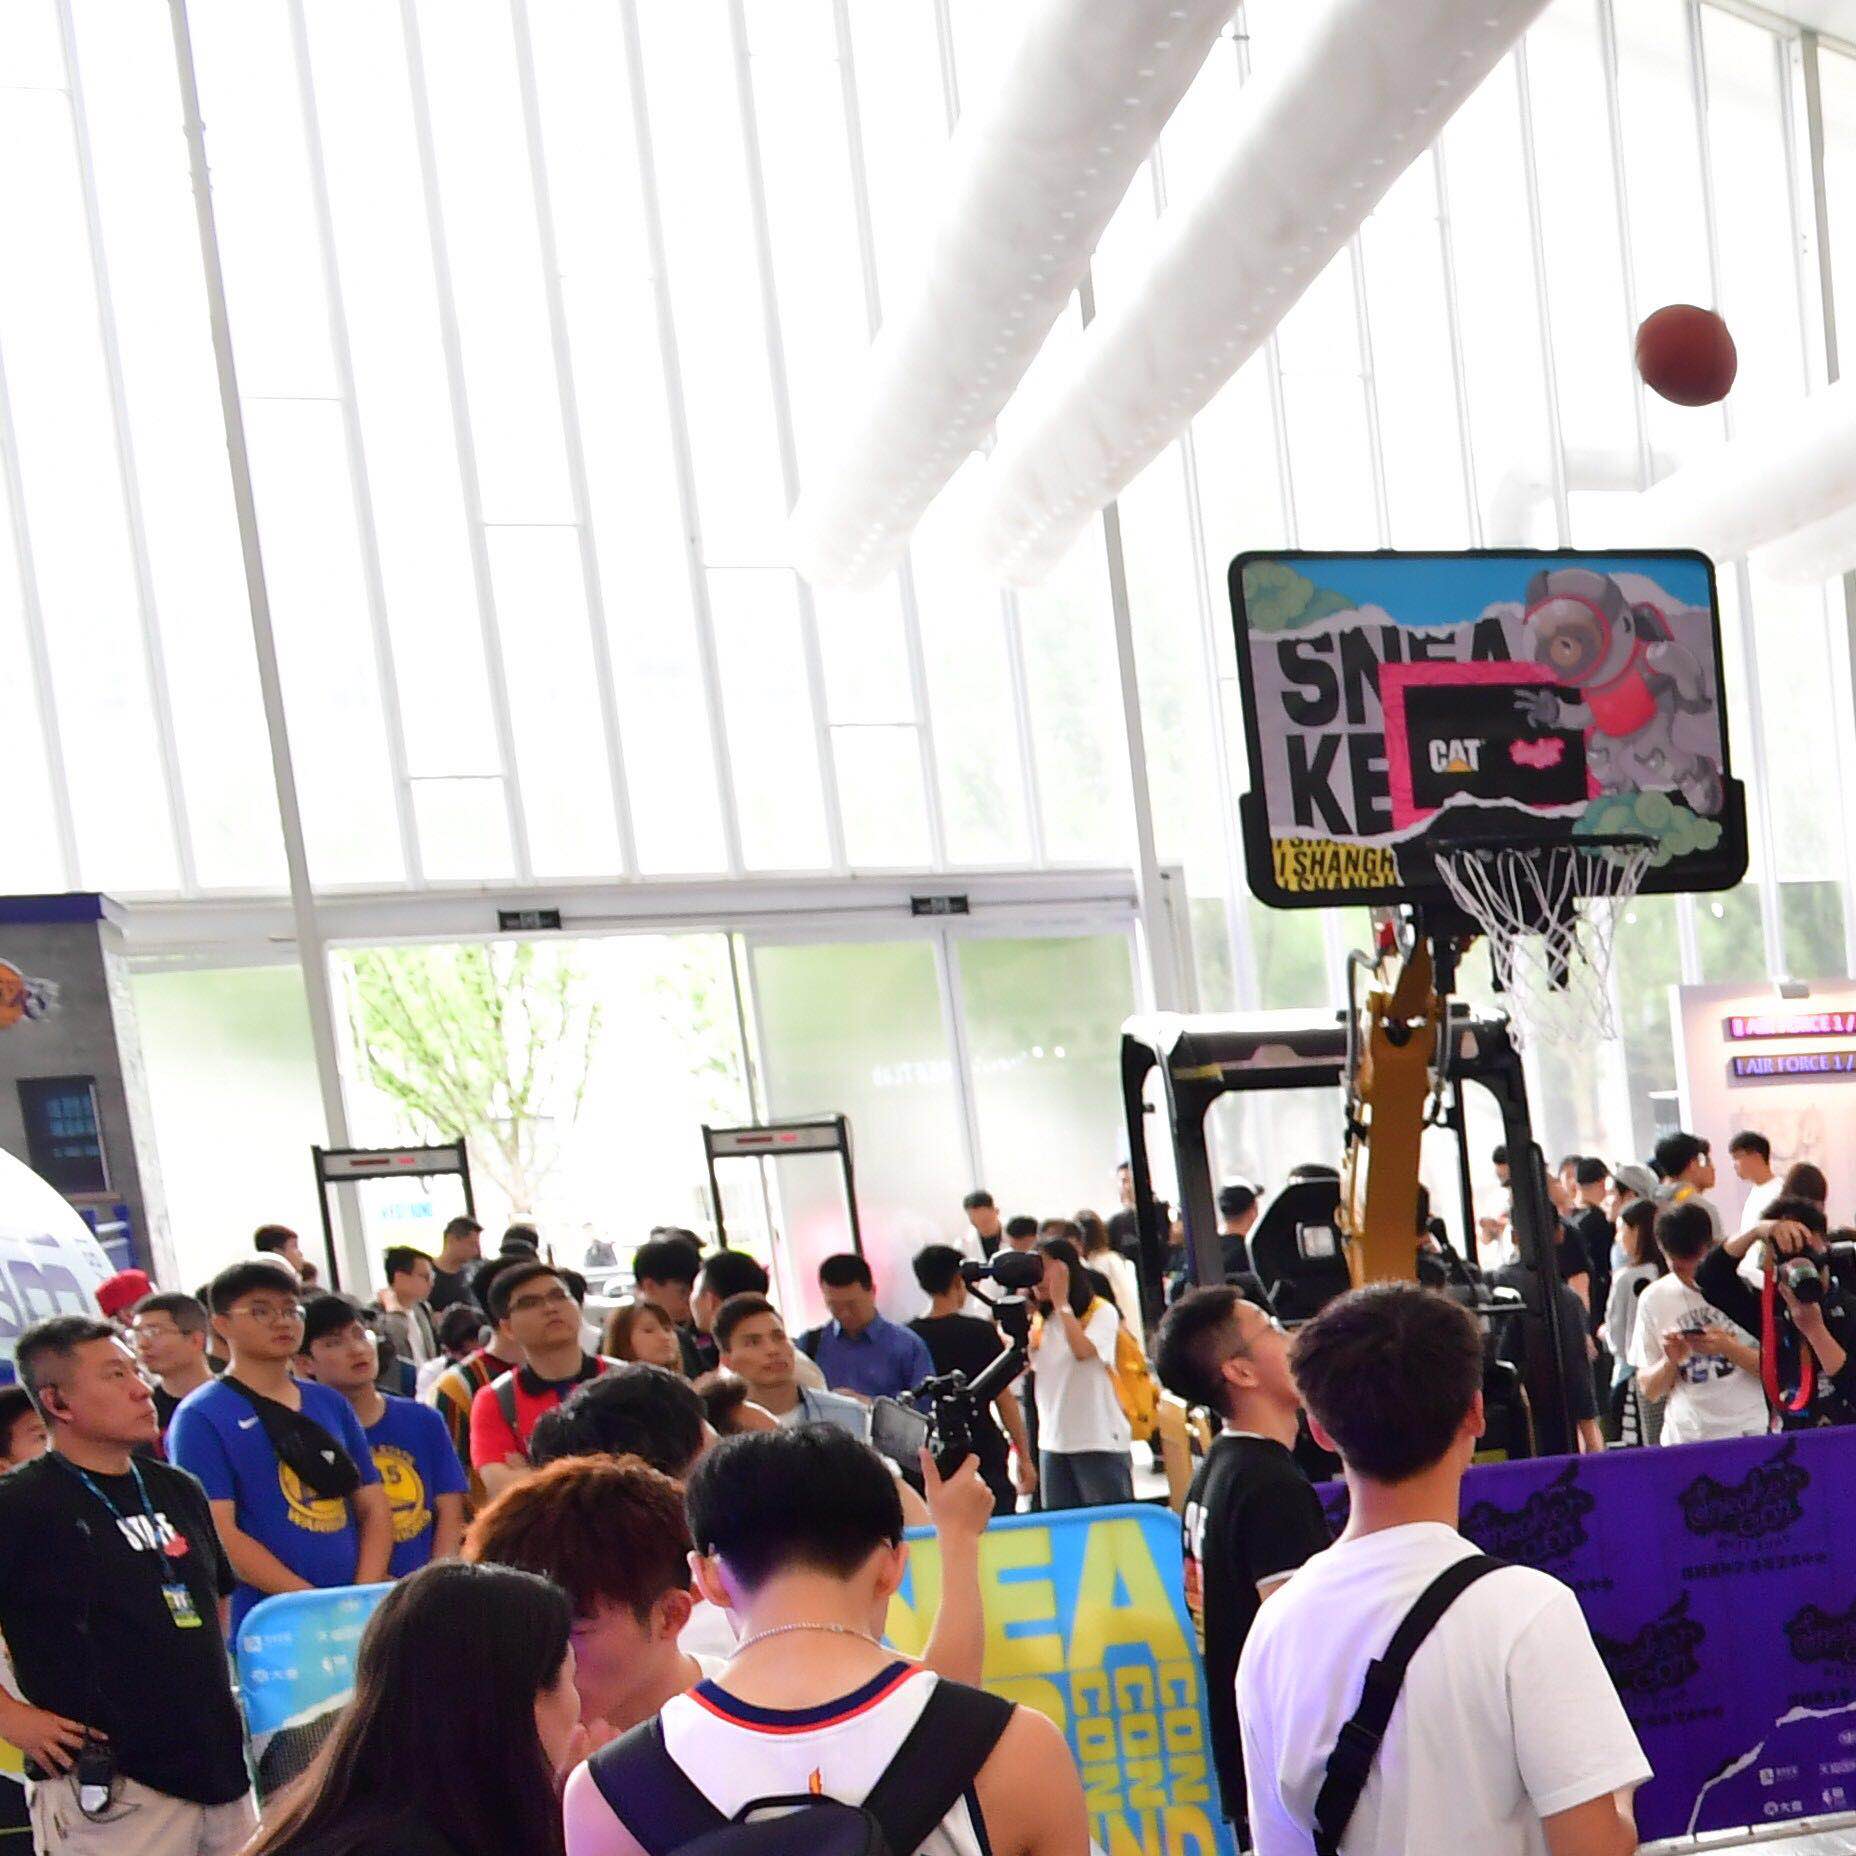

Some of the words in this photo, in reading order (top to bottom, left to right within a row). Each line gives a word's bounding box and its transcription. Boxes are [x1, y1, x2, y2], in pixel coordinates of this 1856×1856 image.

[1428, 738, 1481, 773] CAT
[1746, 1057, 1773, 1074] AIR
[1778, 1054, 1827, 1073] FORCE
